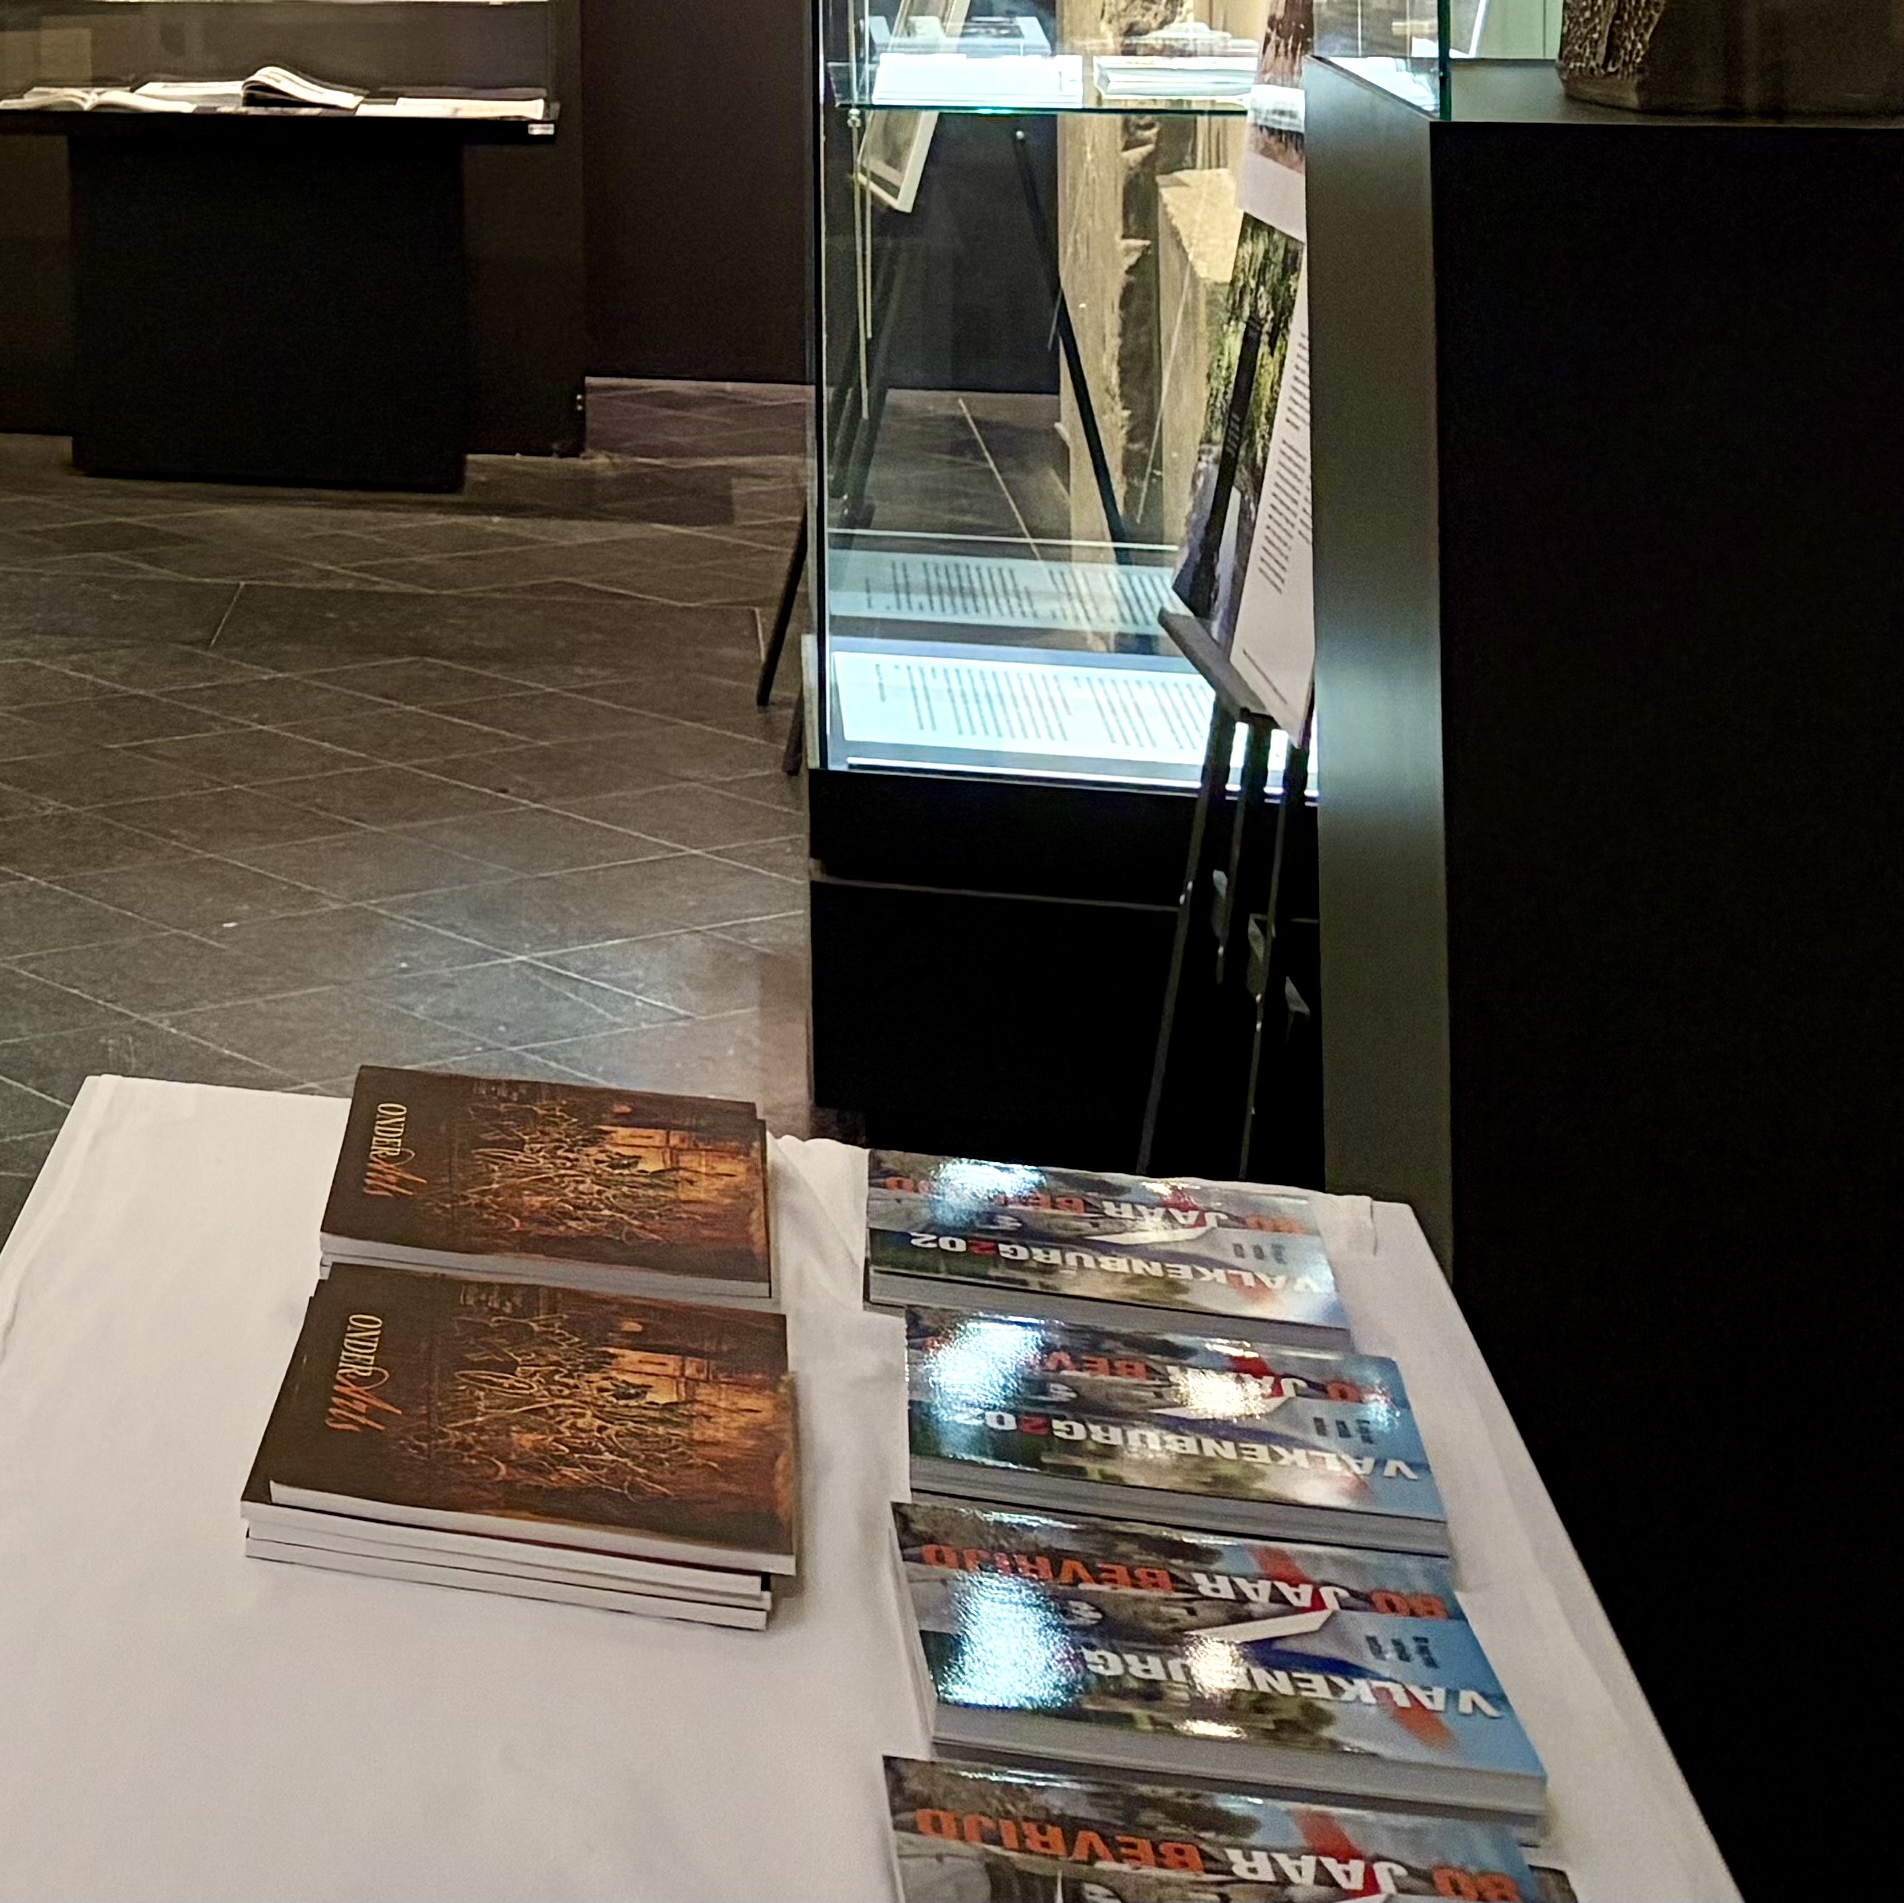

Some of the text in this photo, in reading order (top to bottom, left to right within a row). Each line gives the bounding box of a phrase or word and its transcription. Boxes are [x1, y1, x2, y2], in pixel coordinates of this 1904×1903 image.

[1102, 1200, 1230, 1229] JAAR
[1194, 1573, 1351, 1613] JAAR
[1372, 1589, 1449, 1621] 80
[916, 1807, 1522, 1902] 80 JAAR BEVRIJD
